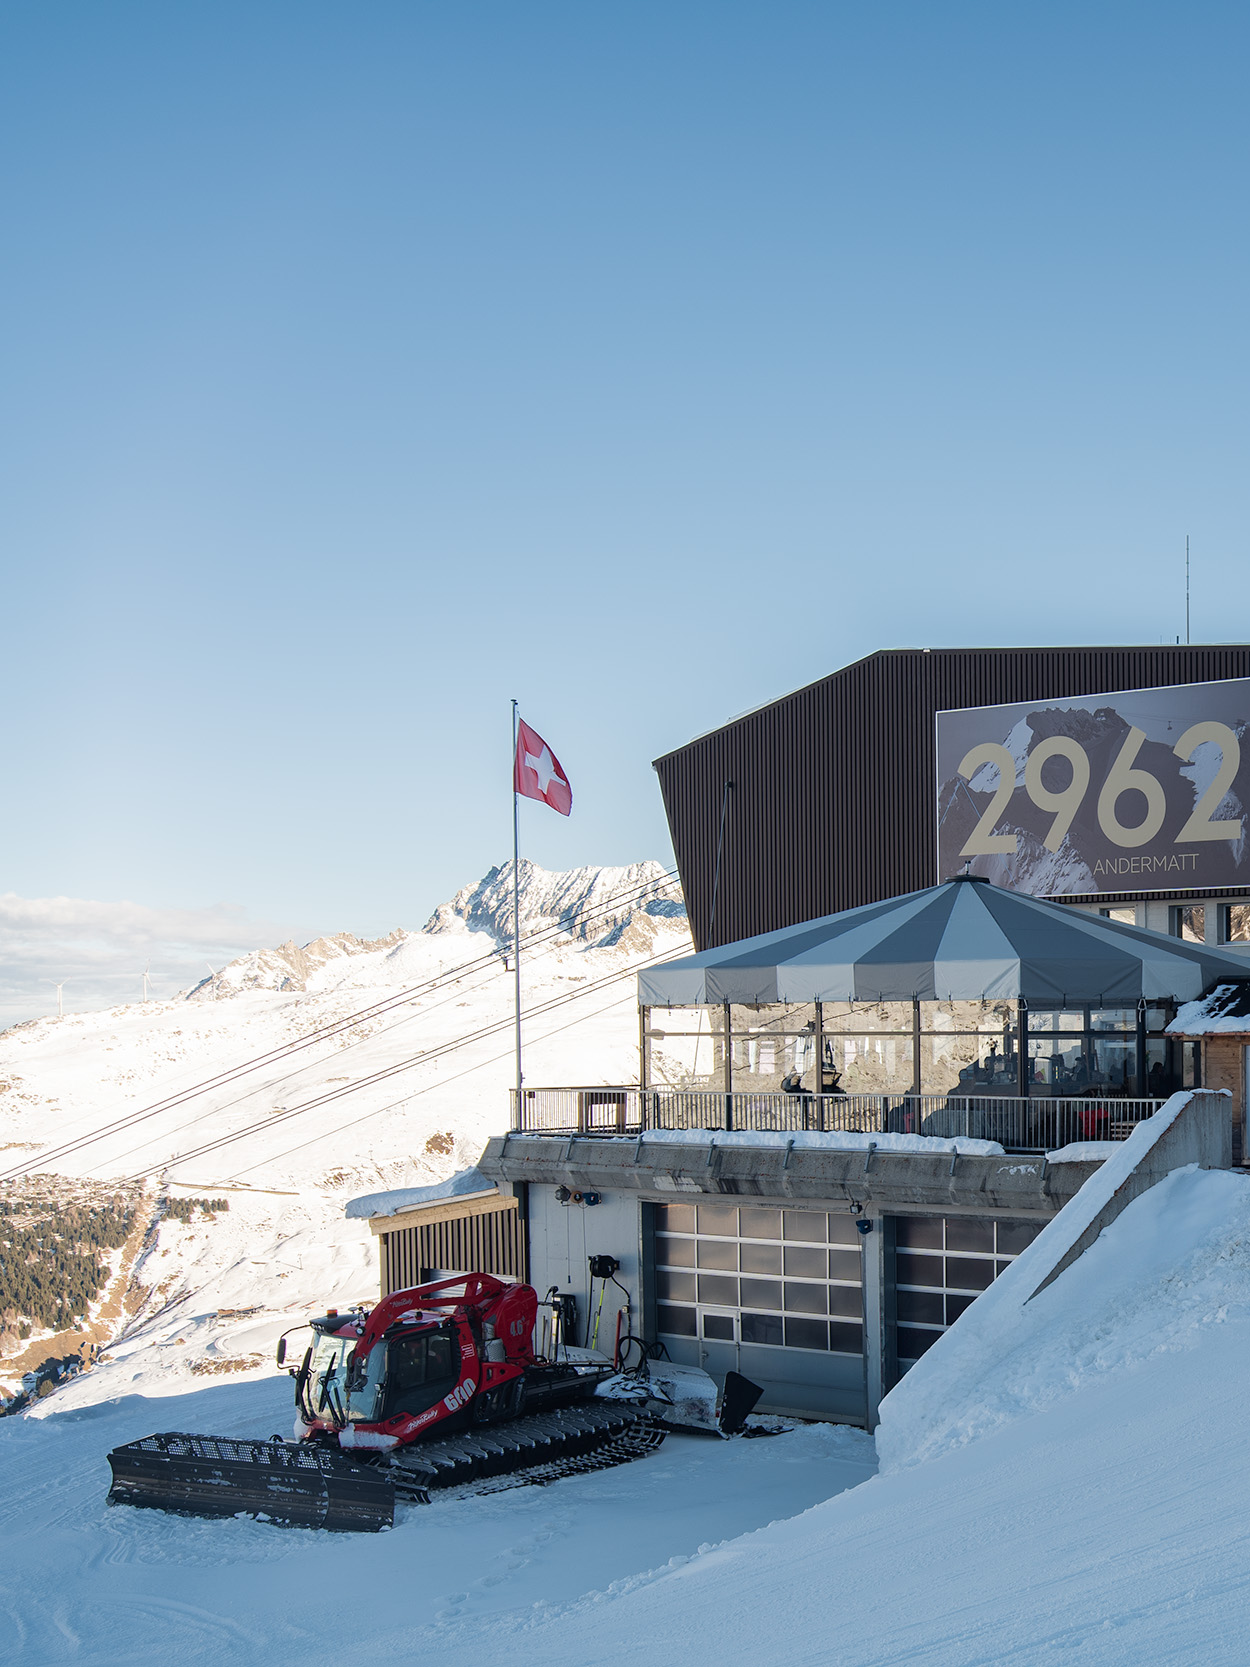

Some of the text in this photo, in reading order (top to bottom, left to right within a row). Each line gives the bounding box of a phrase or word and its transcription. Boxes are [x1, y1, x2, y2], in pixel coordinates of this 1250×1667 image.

[957, 721, 1242, 856] 2962
[1093, 853, 1200, 876] ANDERMATT
[443, 1377, 477, 1412] 600
